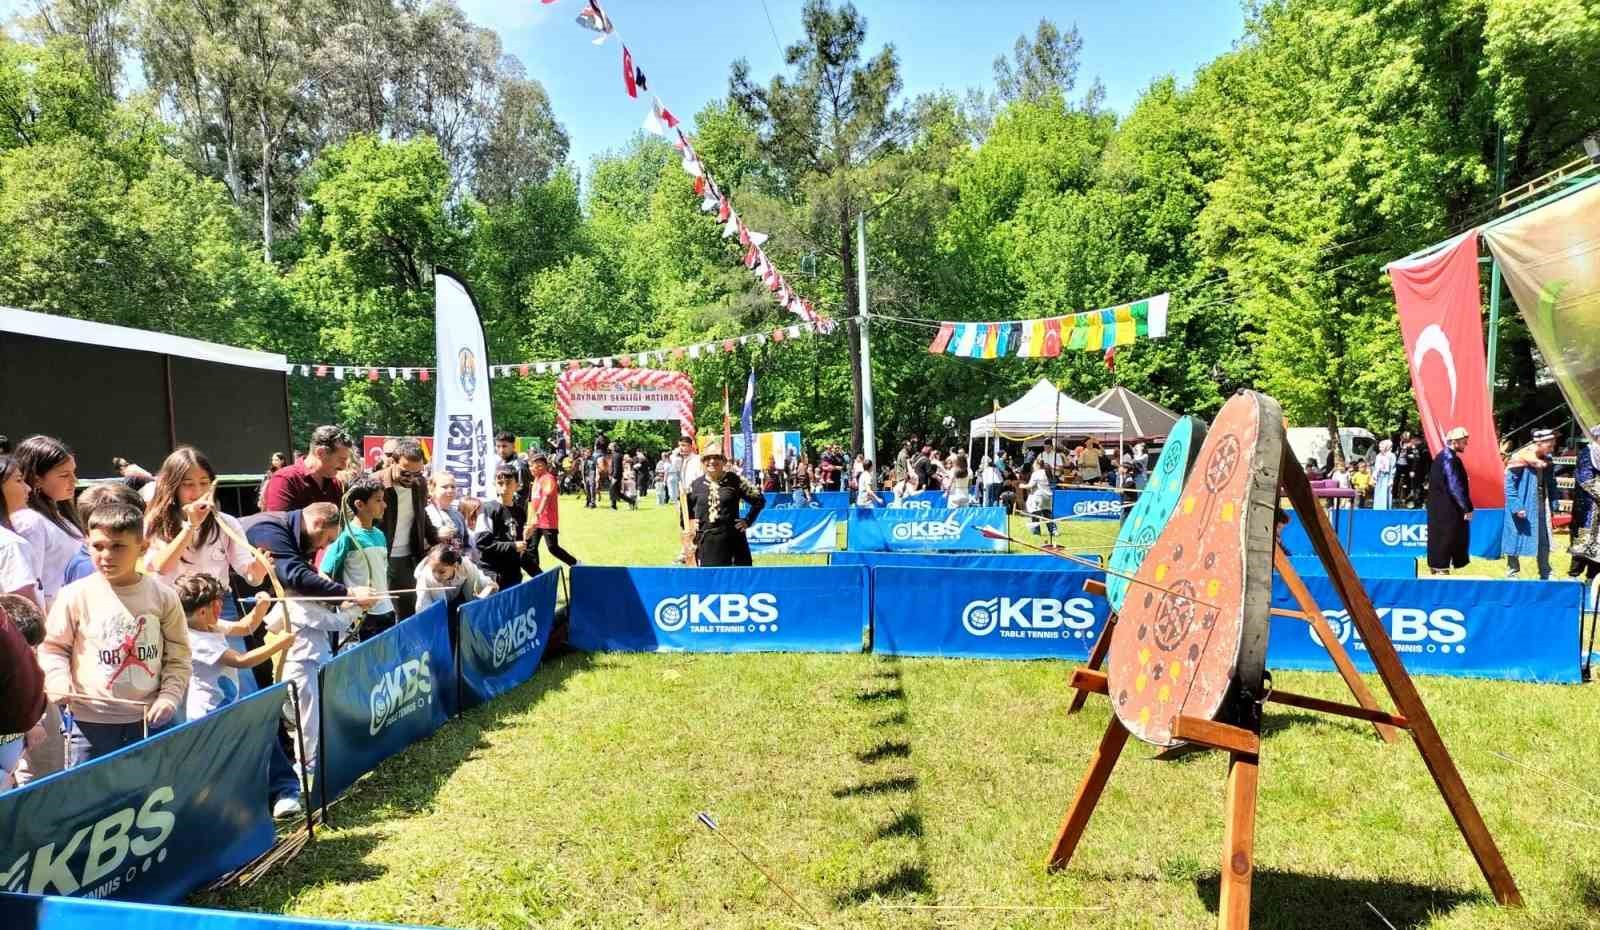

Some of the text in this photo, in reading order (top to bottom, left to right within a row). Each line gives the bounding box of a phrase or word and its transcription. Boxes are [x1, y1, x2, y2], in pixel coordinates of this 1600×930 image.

[645, 393, 679, 401] HATIRAS
[1087, 501, 1120, 514] KBS
[746, 522, 793, 538] KBS
[911, 521, 961, 536] KBS
[690, 592, 779, 624] KBS
[1000, 597, 1095, 630] KBS
[508, 608, 538, 653] KBS
[690, 625, 745, 633] TABLE TENNIS
[1000, 631, 1058, 639] TABLE TENNIS
[1393, 644, 1423, 653] ENNIS
[385, 651, 432, 714] KBS
[28, 785, 175, 896] KBS
